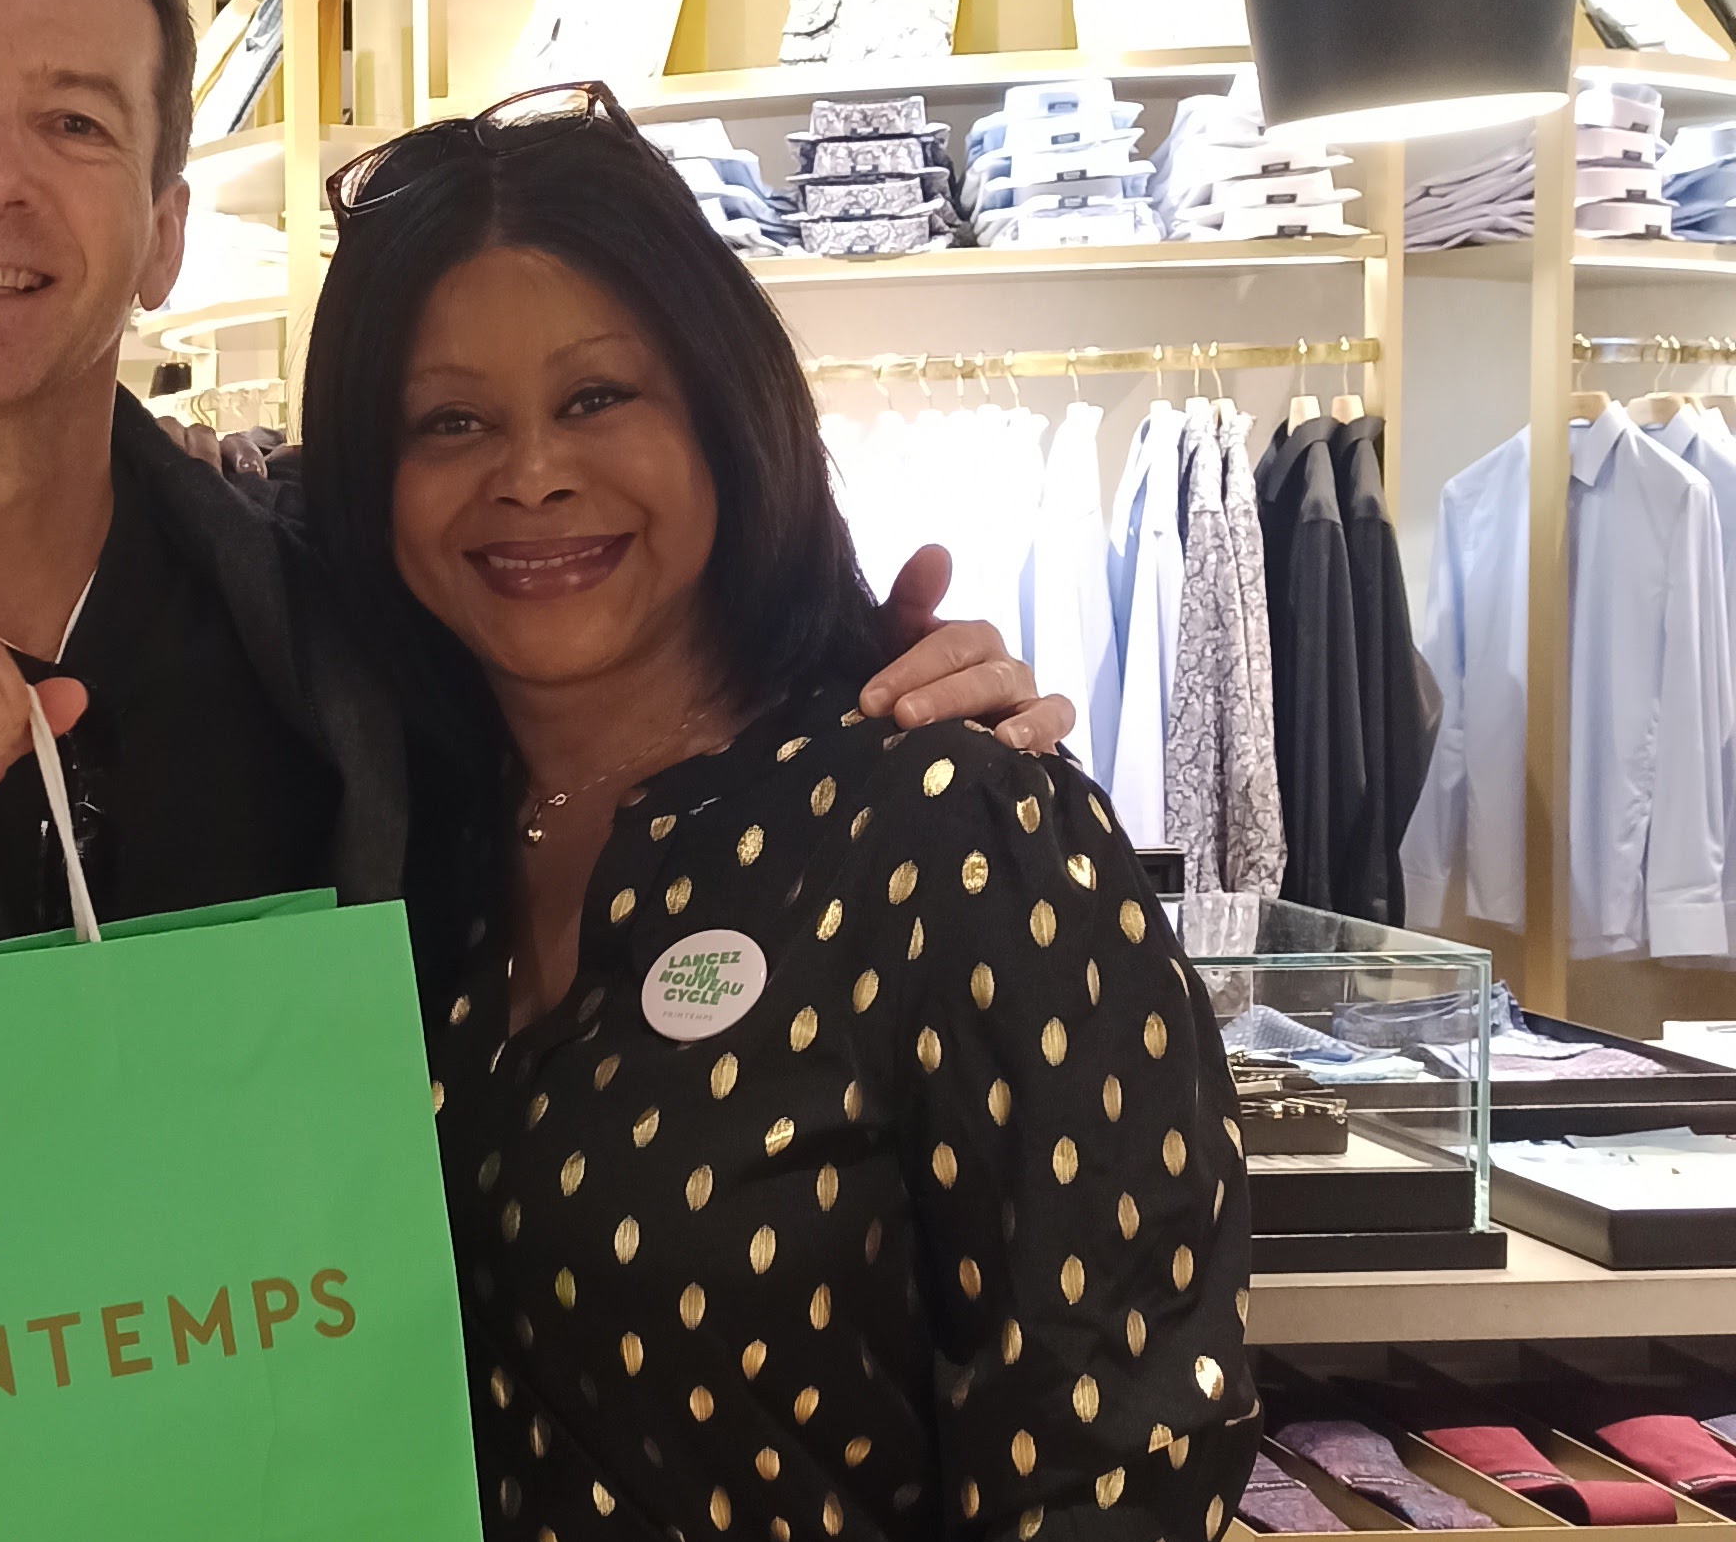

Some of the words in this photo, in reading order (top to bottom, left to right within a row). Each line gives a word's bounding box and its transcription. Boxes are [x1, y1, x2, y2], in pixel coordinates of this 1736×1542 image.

[668, 950, 742, 969] LANCEZ
[694, 964, 720, 980] UN
[658, 969, 744, 996] NOUVEAU
[663, 988, 722, 1006] CYCLE
[661, 1010, 714, 1022] PRINTEMPS
